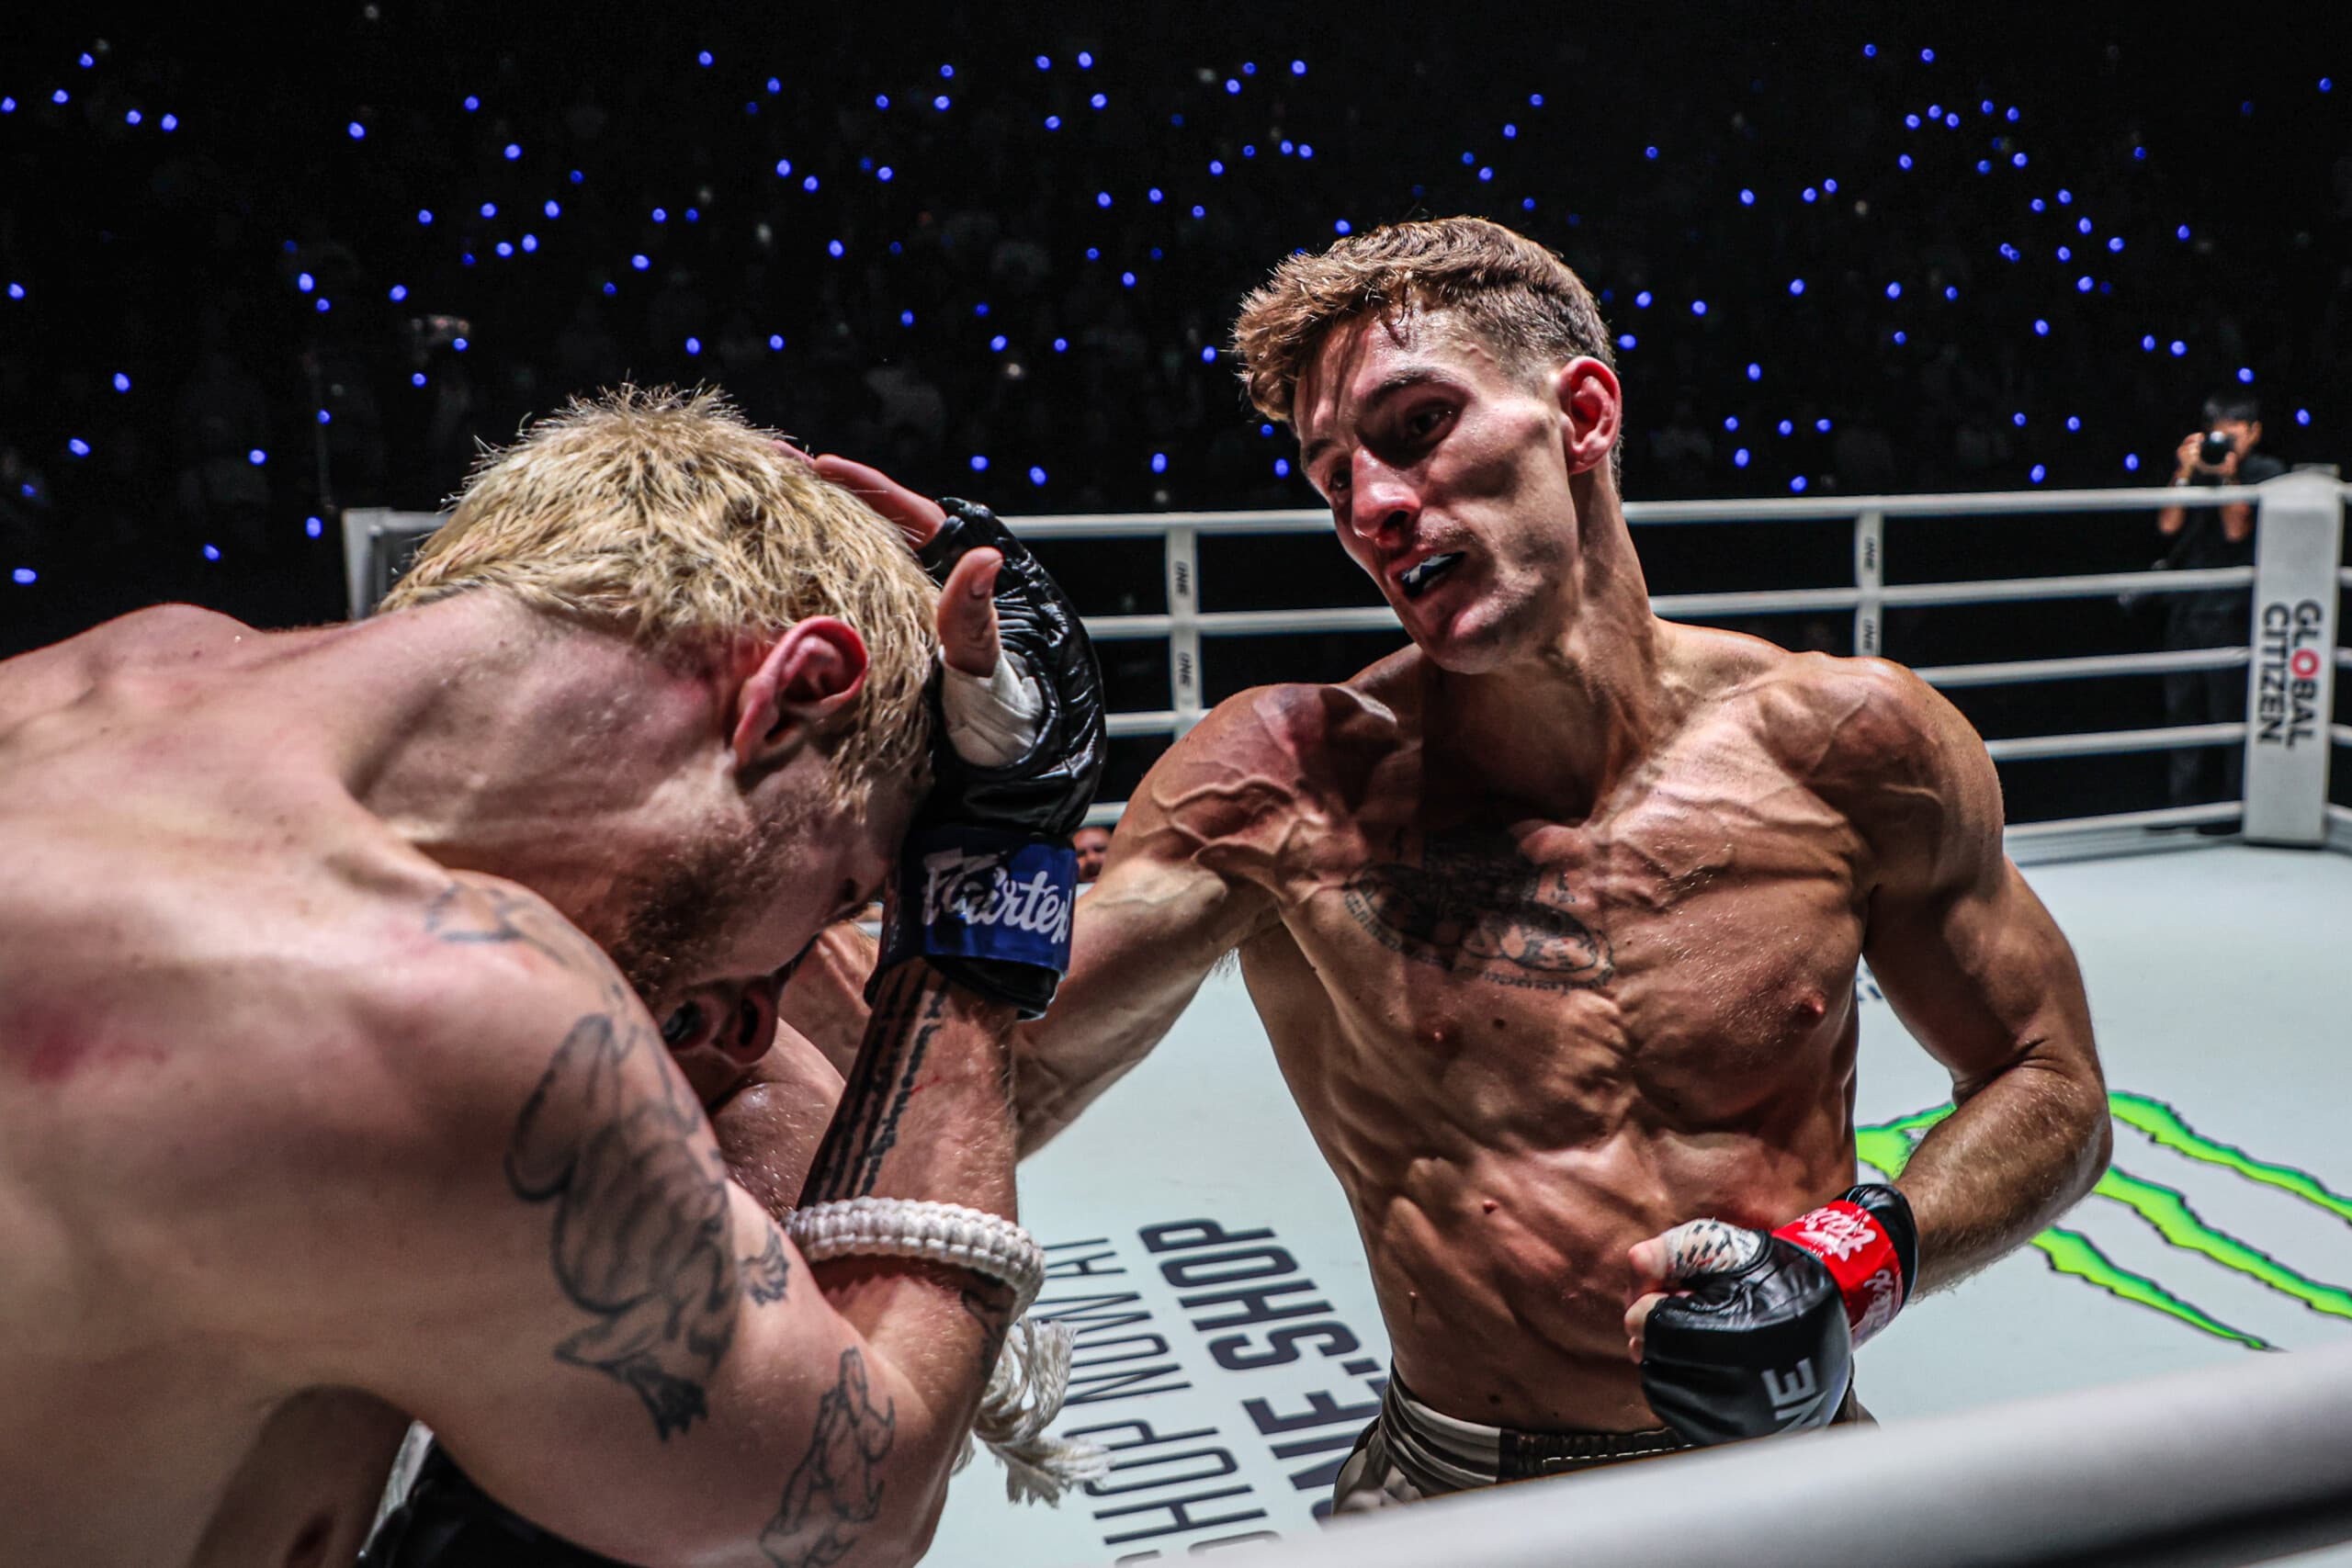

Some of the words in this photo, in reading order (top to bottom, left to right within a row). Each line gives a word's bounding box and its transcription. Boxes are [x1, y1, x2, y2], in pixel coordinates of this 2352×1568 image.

[2258, 604, 2290, 745] CITIZEN
[2287, 599, 2323, 749] GLOBAL
[1030, 1291, 1193, 1407] NOW
[1137, 1218, 1390, 1531] NE.SHOP
[1761, 1357, 1828, 1433] NE
